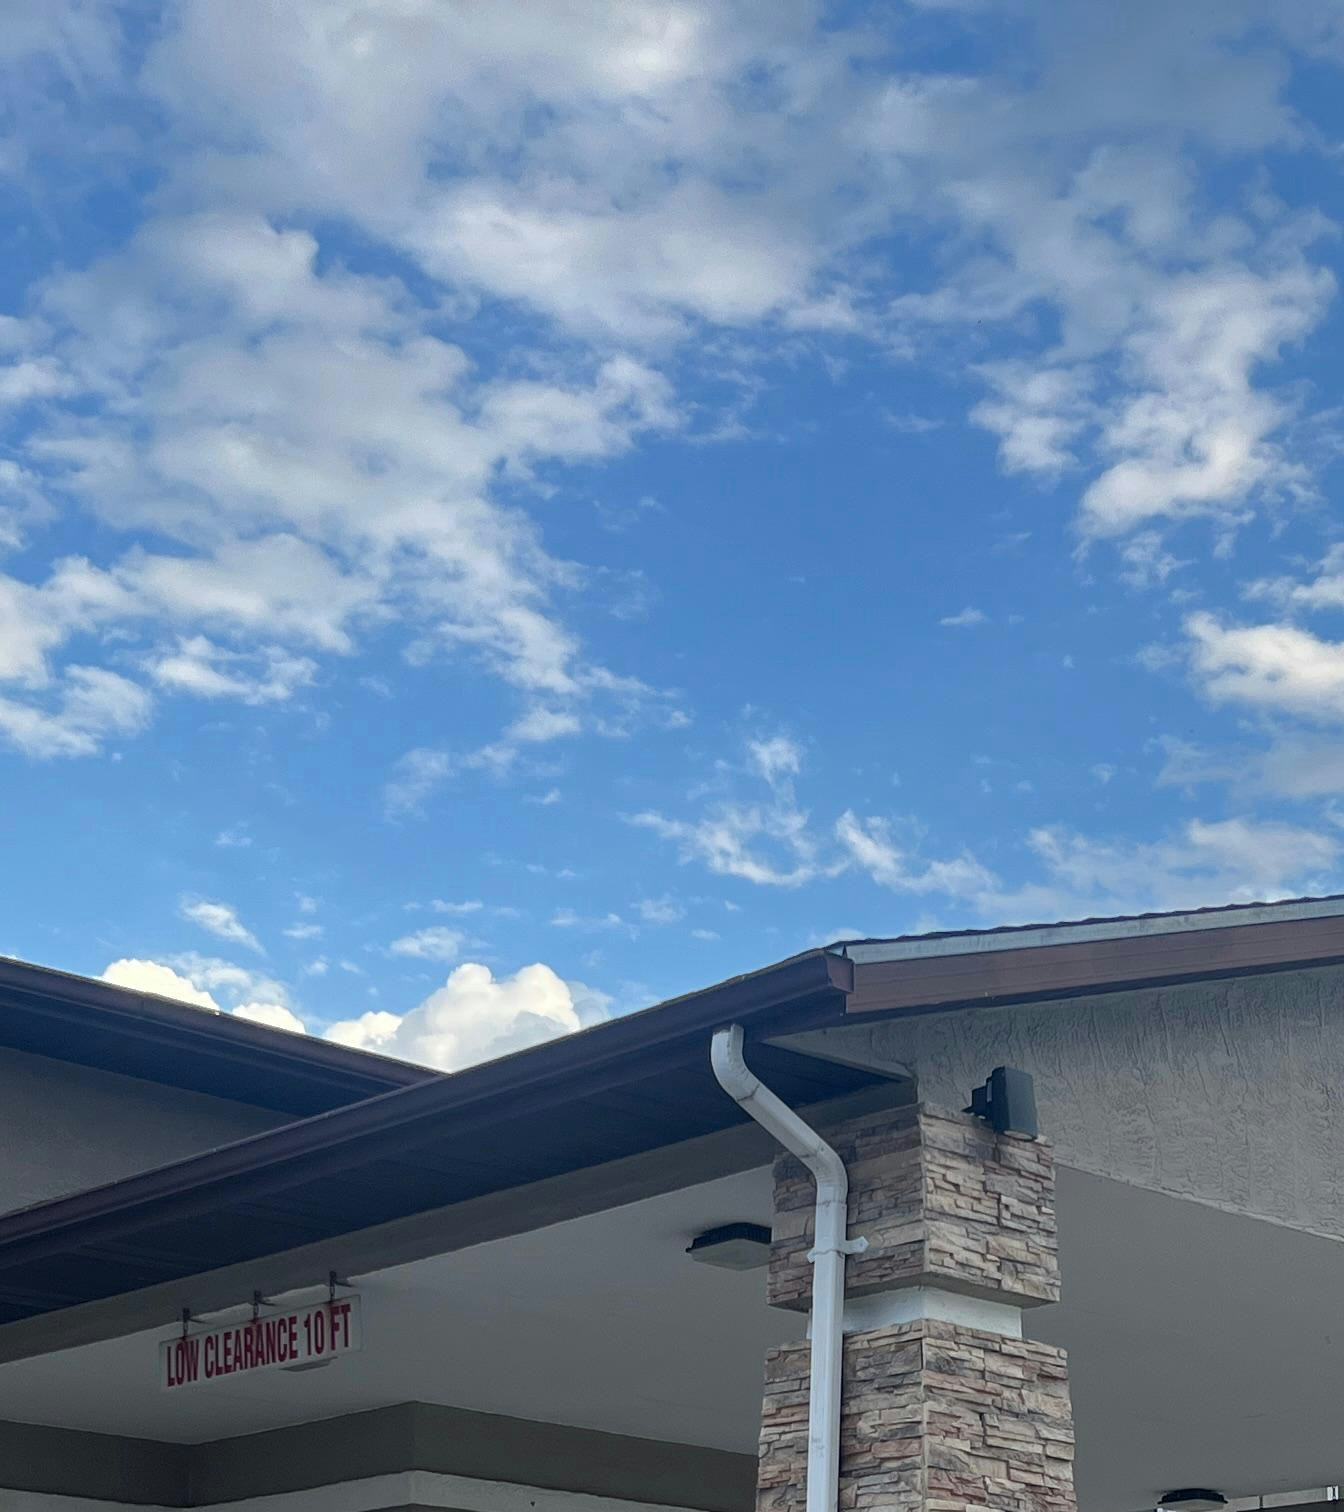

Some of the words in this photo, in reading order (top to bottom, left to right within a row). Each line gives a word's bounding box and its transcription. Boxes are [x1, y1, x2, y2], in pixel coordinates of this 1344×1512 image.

[167, 1338, 200, 1387] LOW
[204, 1316, 299, 1379] CLEARANCE
[304, 1310, 325, 1356] 10
[329, 1304, 352, 1351] FT
